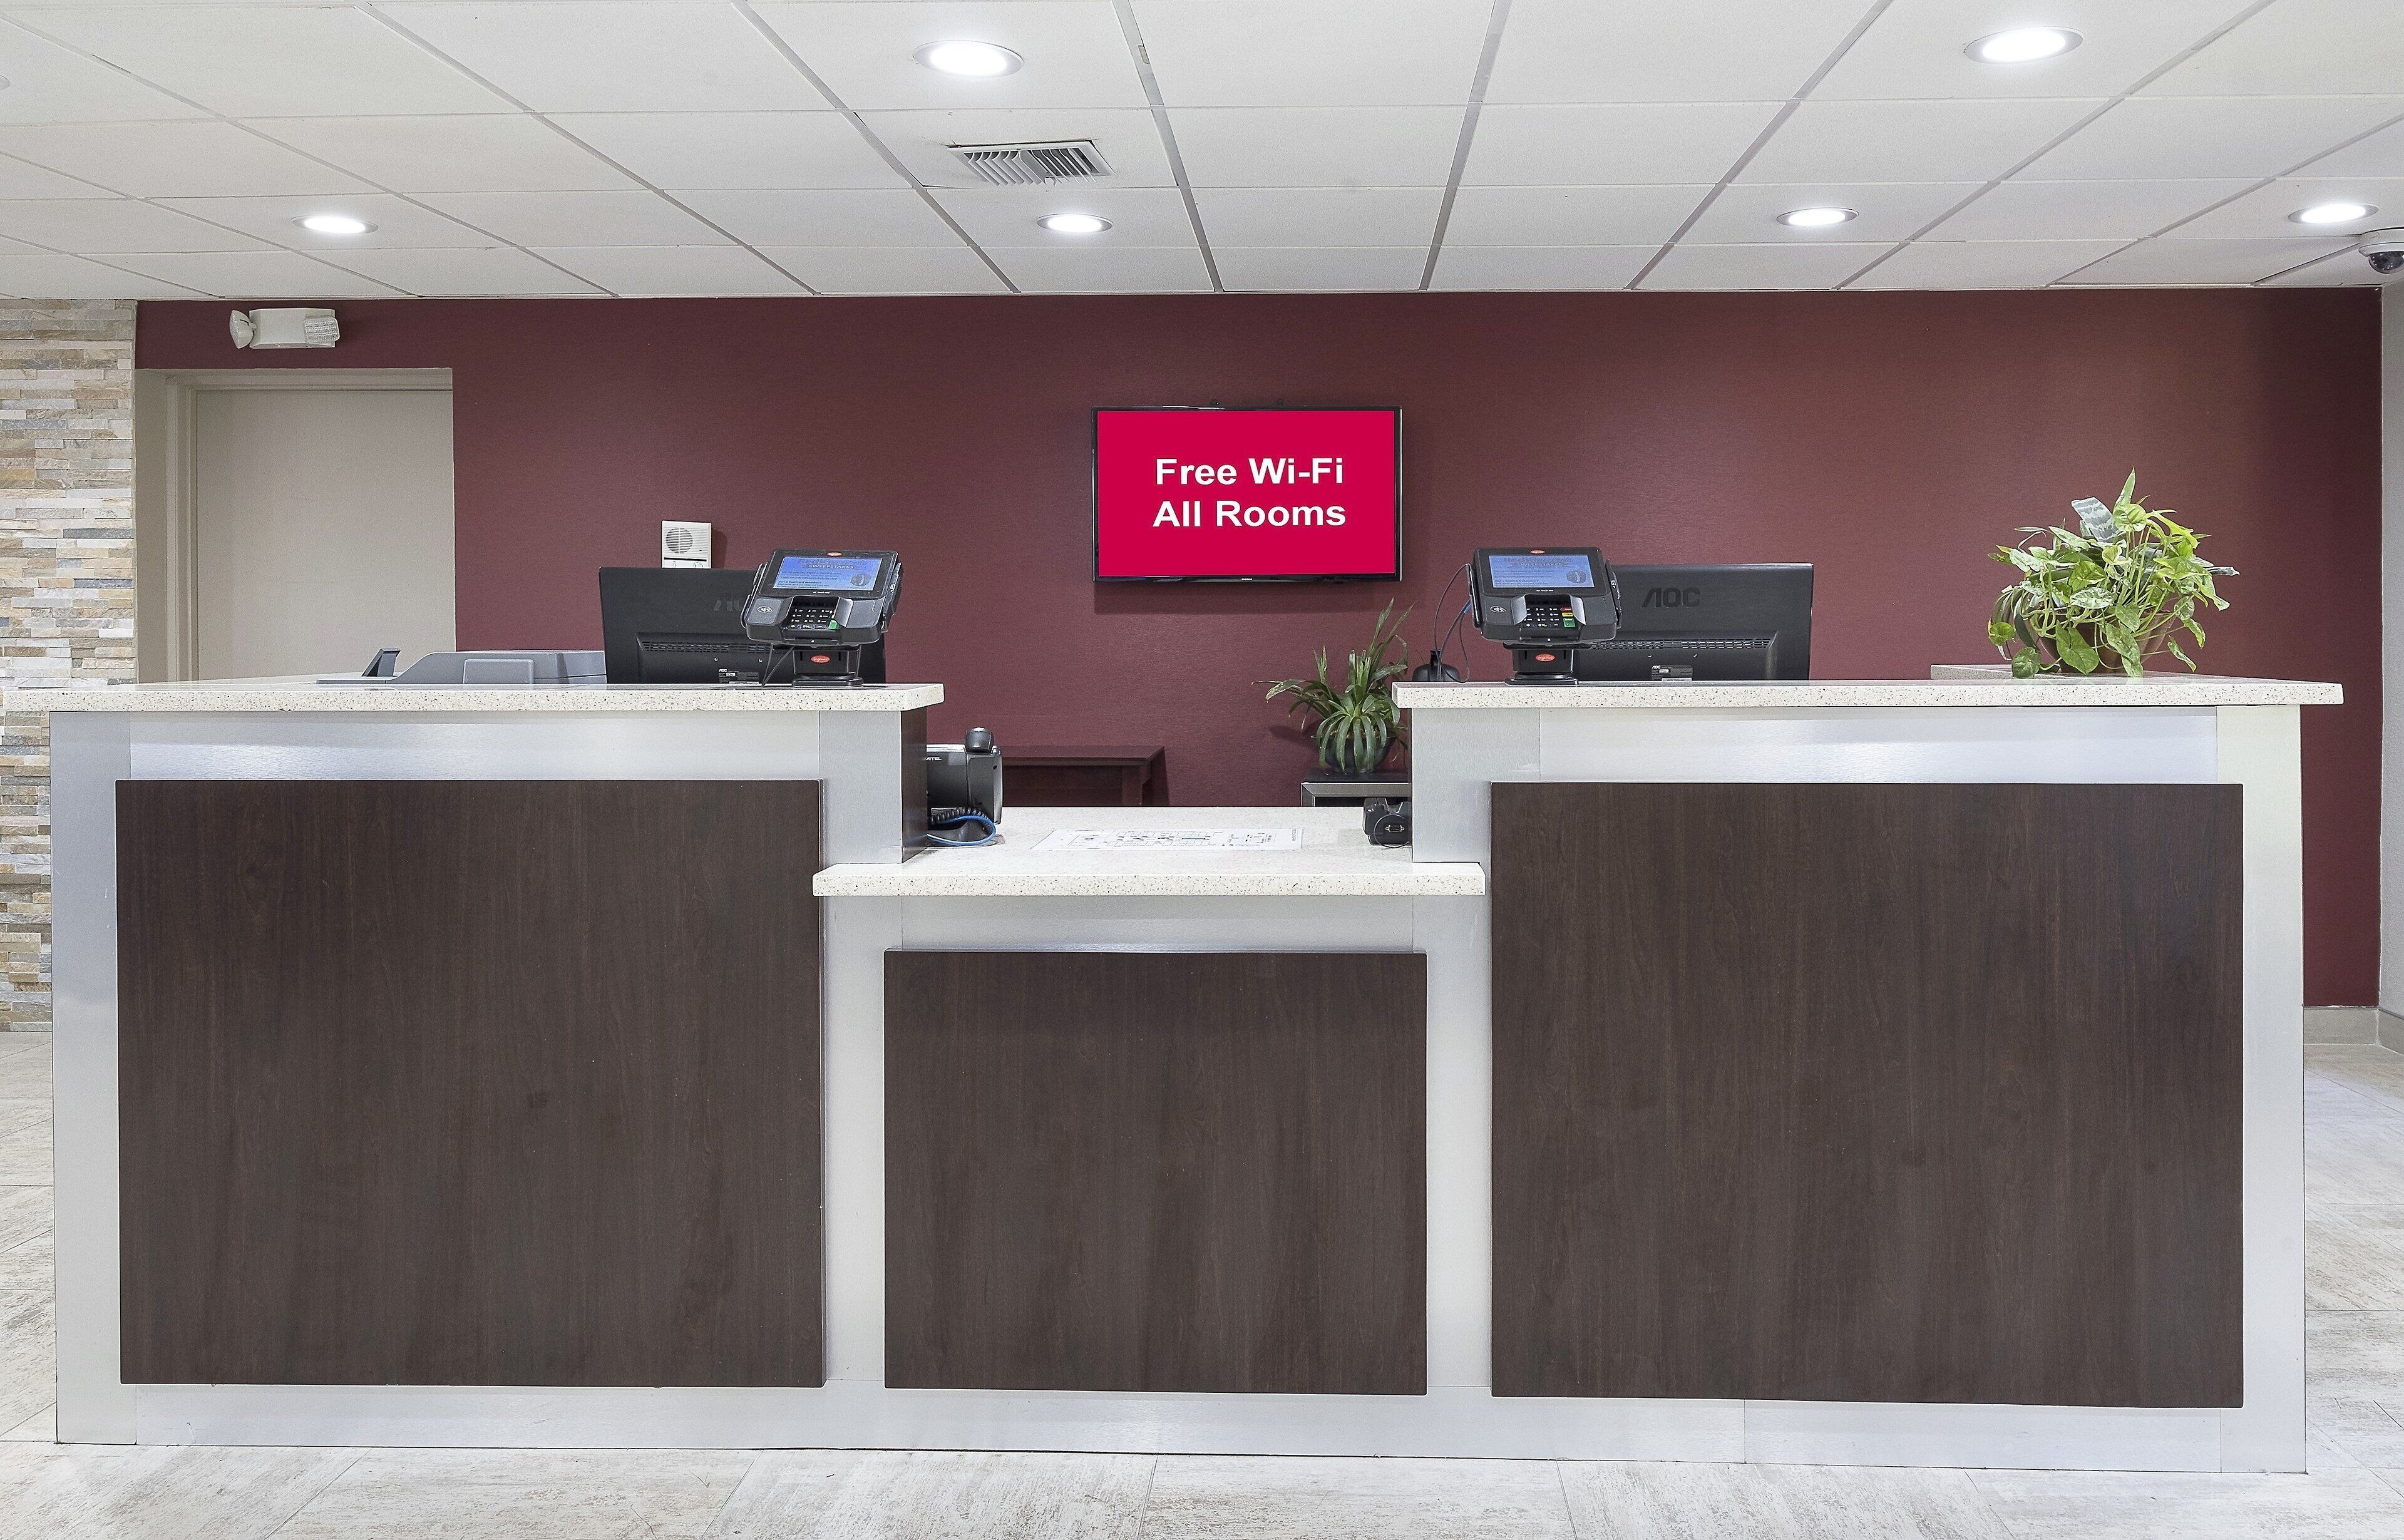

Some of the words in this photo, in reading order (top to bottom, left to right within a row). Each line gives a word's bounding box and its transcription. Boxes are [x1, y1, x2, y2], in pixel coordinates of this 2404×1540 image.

[1157, 459, 1236, 485] Free
[1249, 458, 1342, 484] Wi-Fi
[1153, 501, 1200, 526] All
[1217, 501, 1345, 526] Rooms
[1641, 587, 1700, 608] AOC
